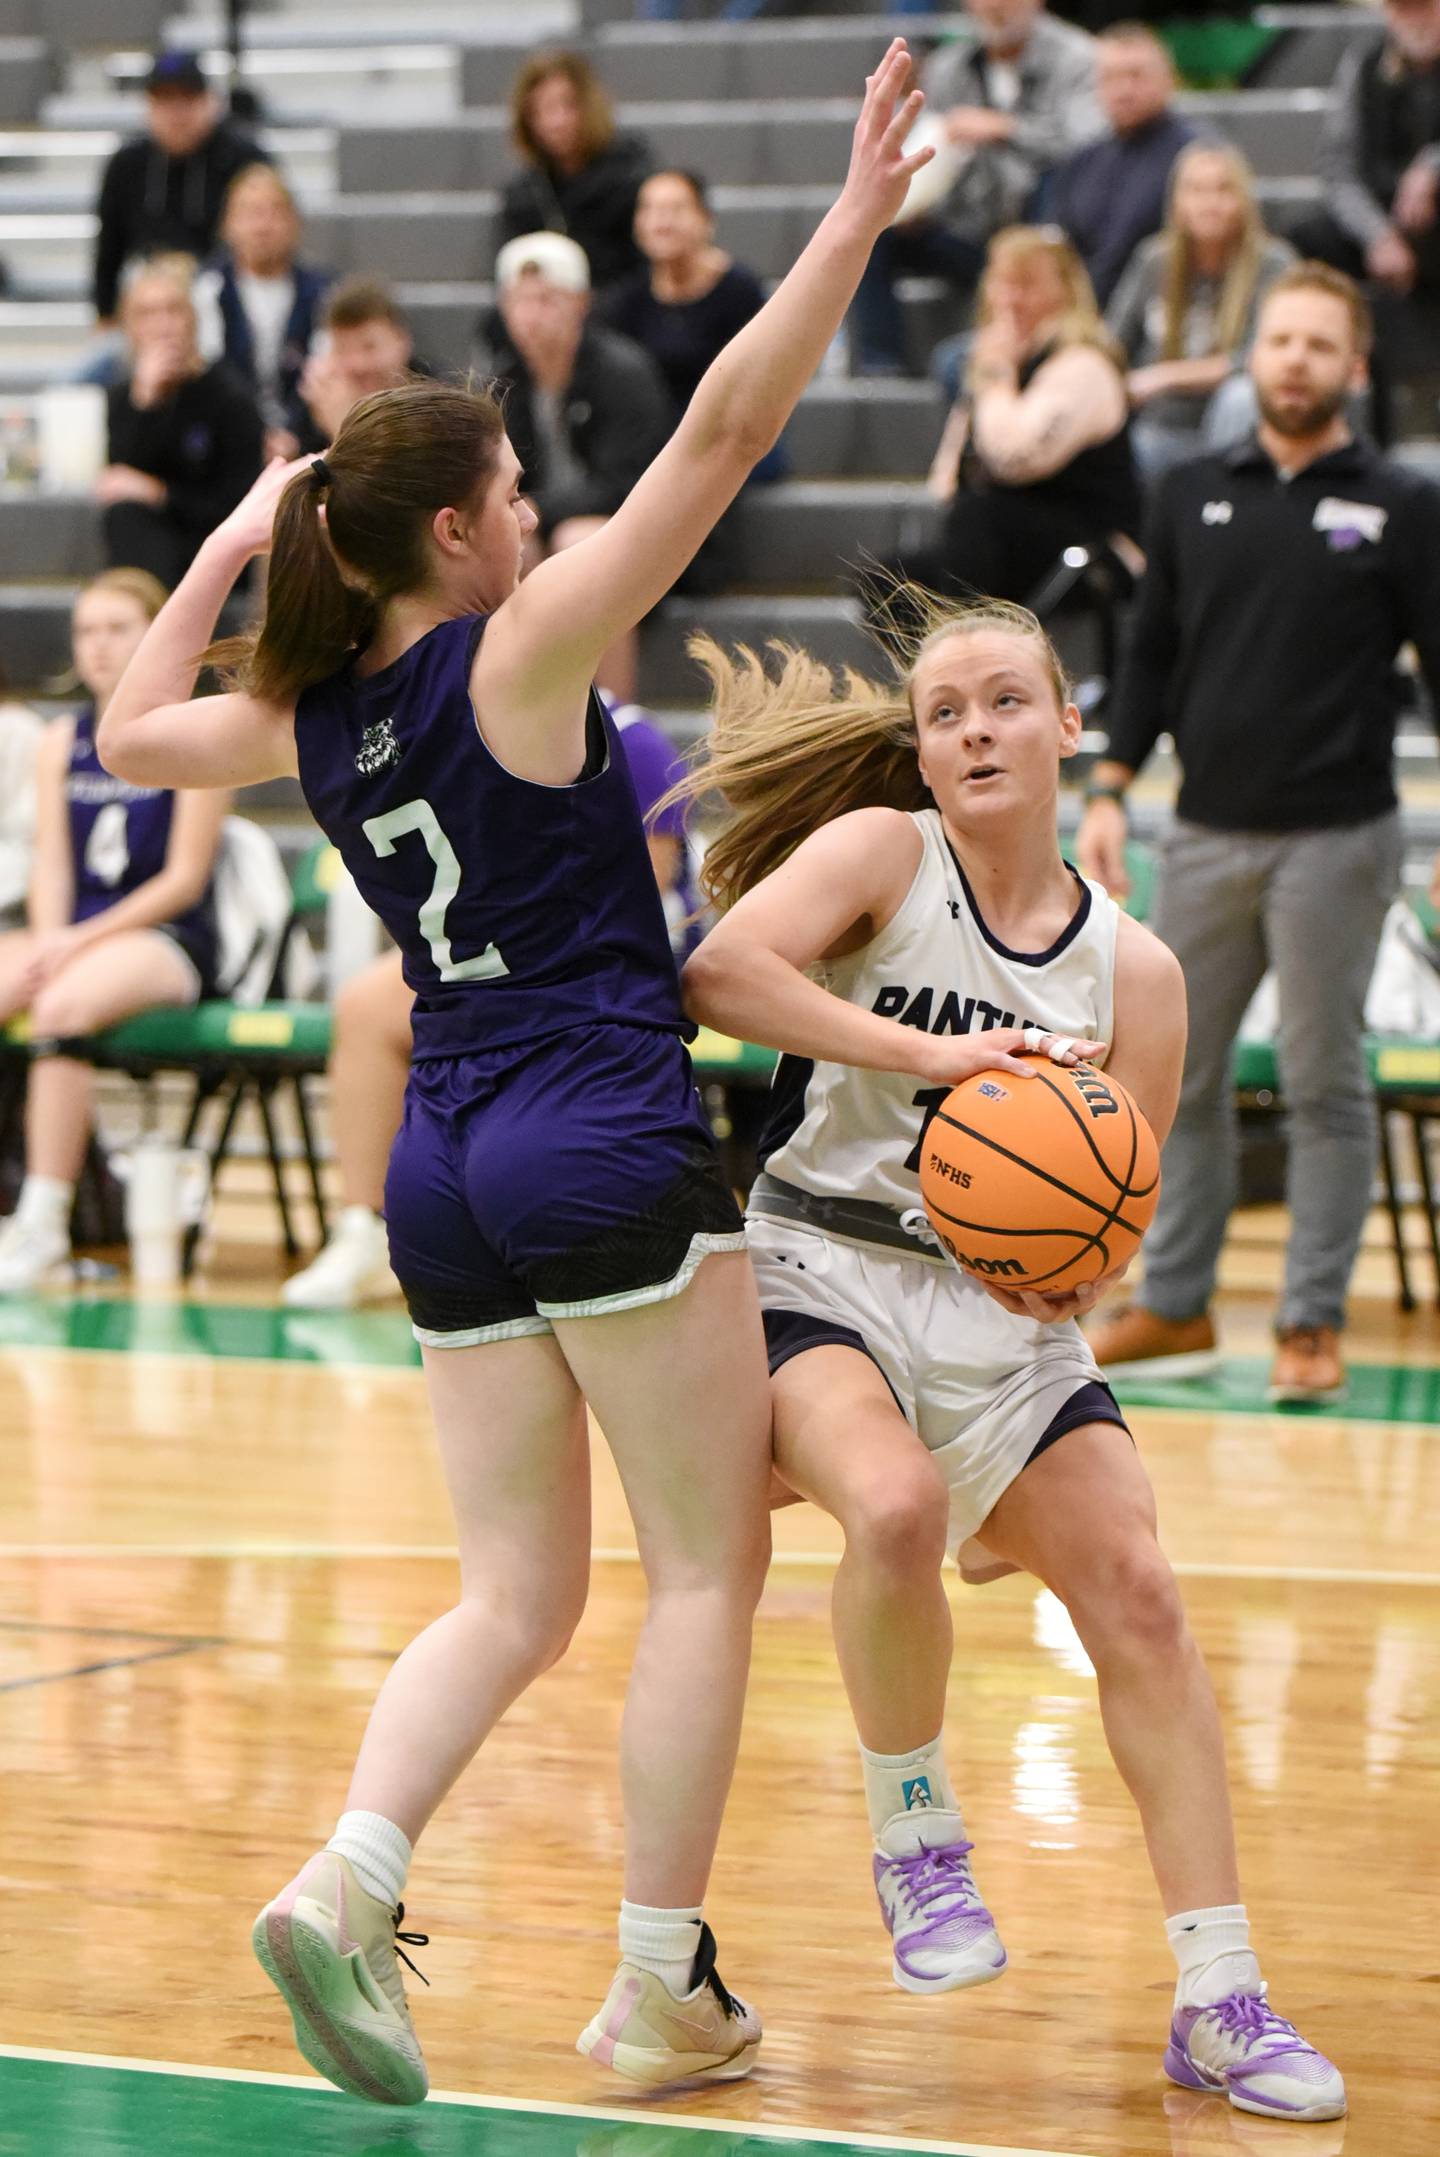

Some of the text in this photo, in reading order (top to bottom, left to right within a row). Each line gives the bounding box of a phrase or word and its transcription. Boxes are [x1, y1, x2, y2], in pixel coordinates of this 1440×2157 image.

[84, 803, 130, 886] 4
[362, 798, 510, 982] 2
[871, 986, 1056, 1035] PANT
[936, 1158, 972, 1190] NFHS
